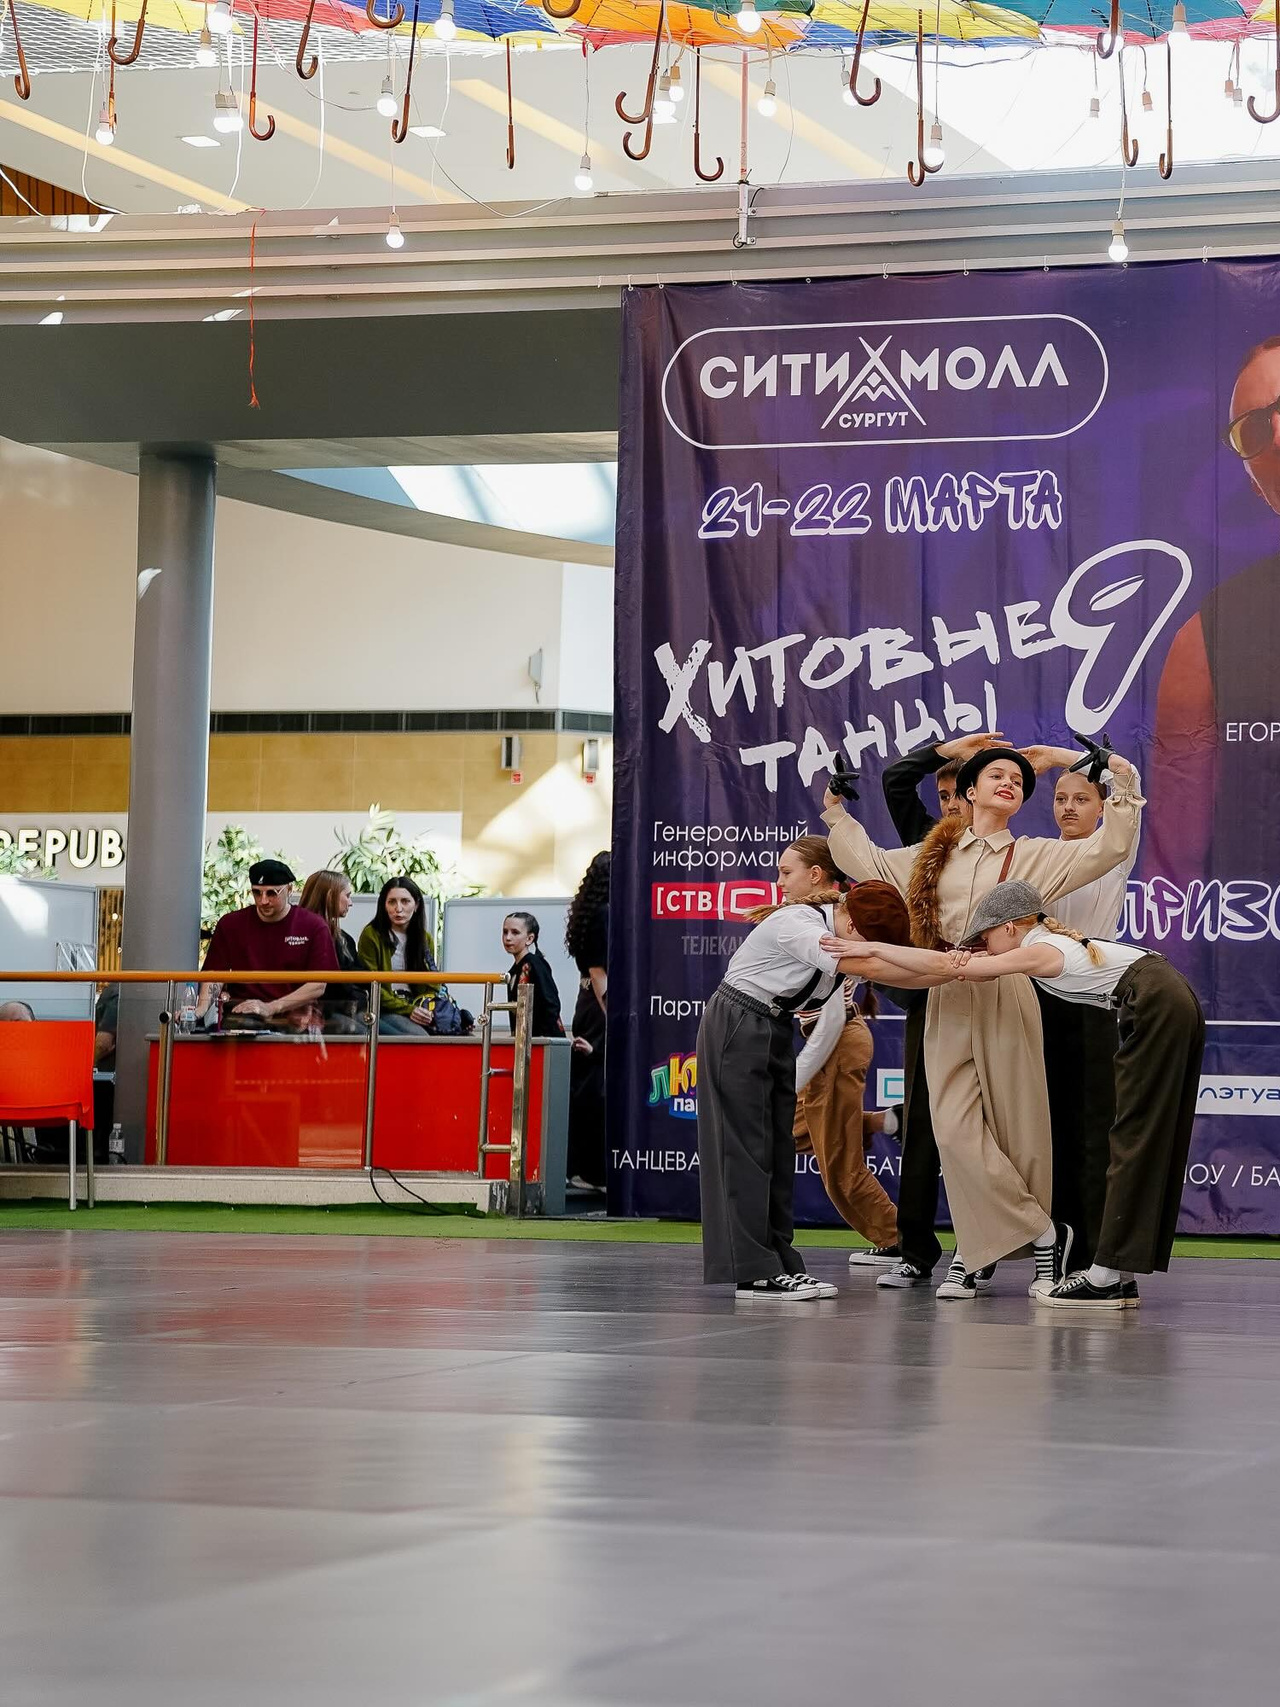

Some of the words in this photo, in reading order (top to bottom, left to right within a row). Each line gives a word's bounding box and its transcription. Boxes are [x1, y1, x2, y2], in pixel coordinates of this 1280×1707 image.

[700, 352, 851, 399] СИТИ
[900, 343, 1069, 391] МОЛЛ
[838, 410, 909, 429] СУРГУТ
[697, 481, 872, 539] 21-22
[883, 470, 1063, 533] МАРТА
[739, 681, 997, 793] ТАНЦЫ
[0, 828, 124, 869] EPUB
[653, 820, 809, 846] Генеральный
[681, 935, 742, 956] ТЕЛЕКА
[611, 1149, 700, 1173] ТАНЦЕВА
[1183, 1163, 1226, 1185] ОУ
